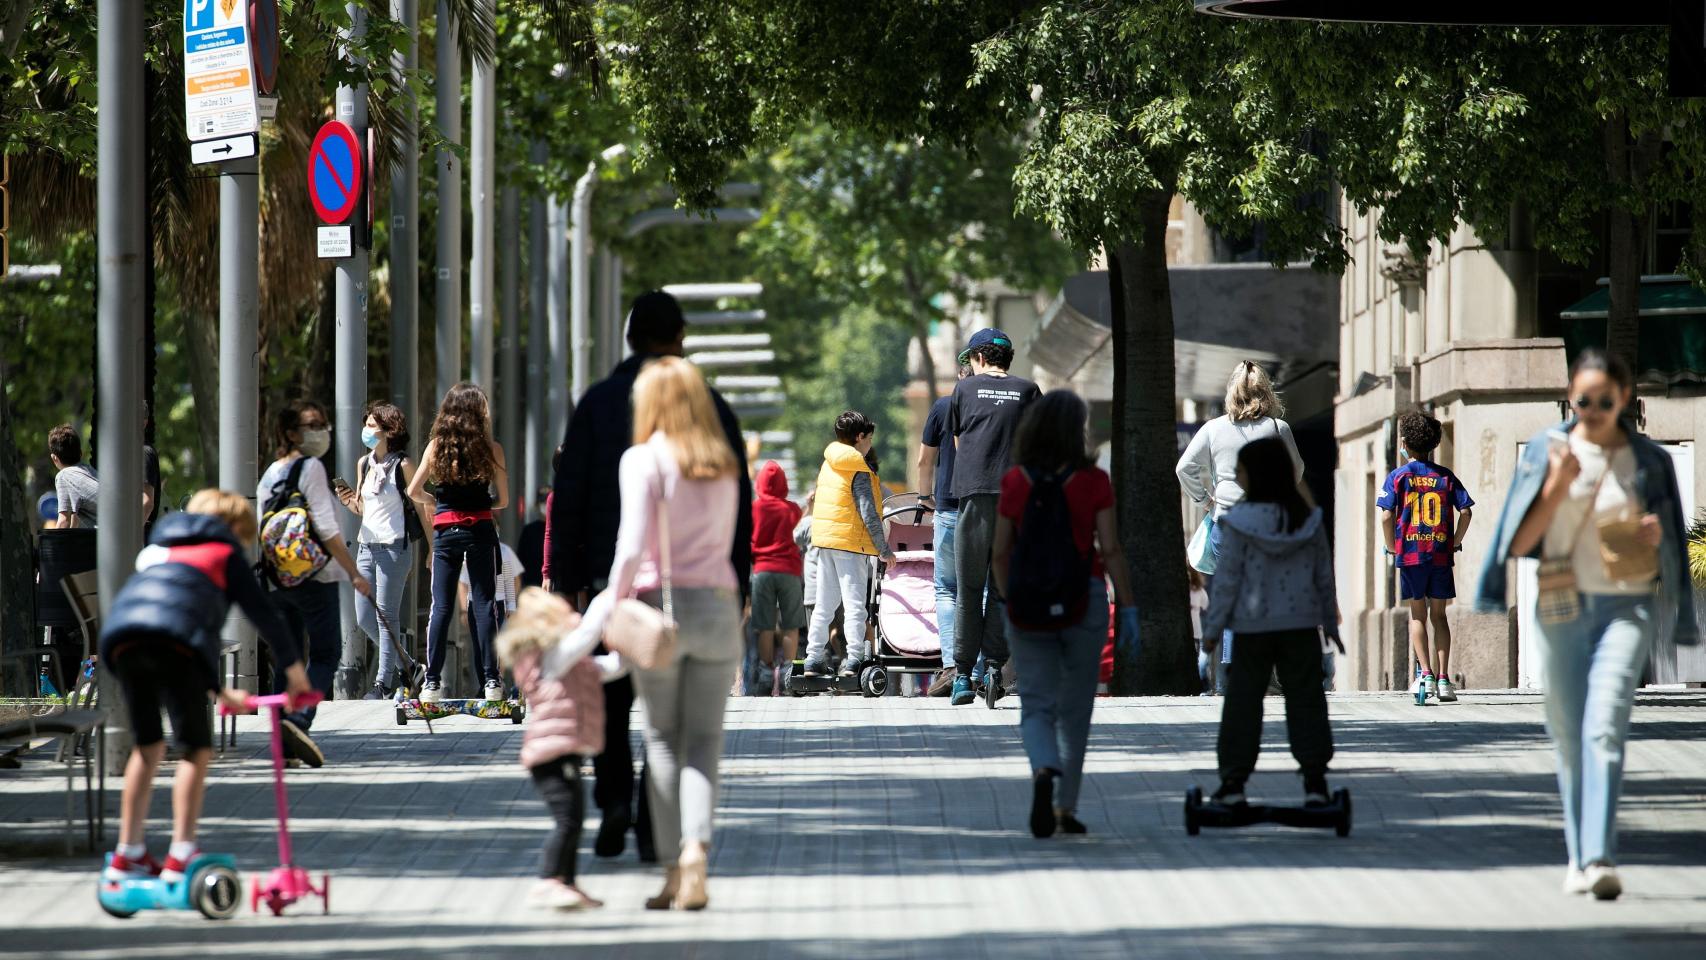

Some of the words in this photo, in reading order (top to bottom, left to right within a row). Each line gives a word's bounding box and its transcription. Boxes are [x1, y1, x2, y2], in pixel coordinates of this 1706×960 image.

[192, 0, 208, 27] P
[1408, 477, 1437, 487] MESSI
[1405, 491, 1441, 527] 10
[1406, 531, 1435, 541] unicef
